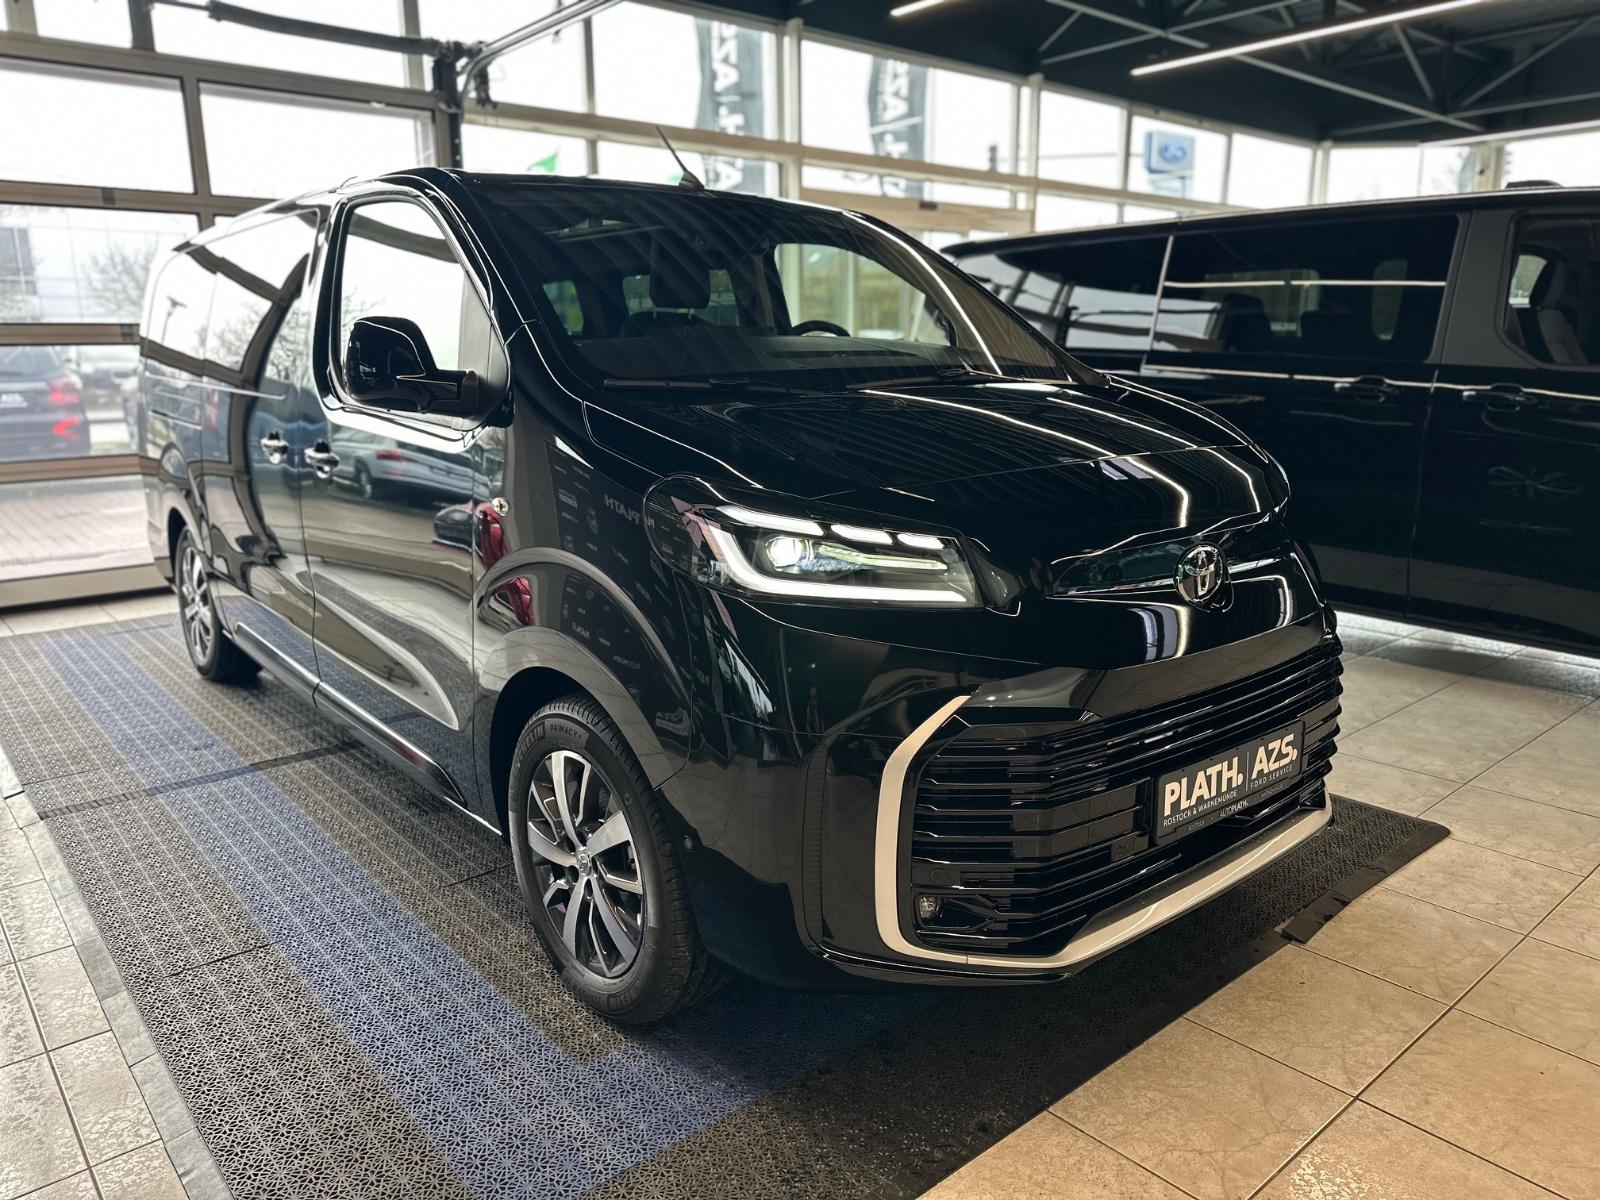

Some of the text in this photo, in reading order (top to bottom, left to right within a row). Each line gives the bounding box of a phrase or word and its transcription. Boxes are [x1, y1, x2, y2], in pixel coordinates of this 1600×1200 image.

[550, 723, 578, 737] PRIMACY
[1250, 764, 1293, 790] FORD SERVICE
[1163, 809, 1192, 827] ROSTOCK
